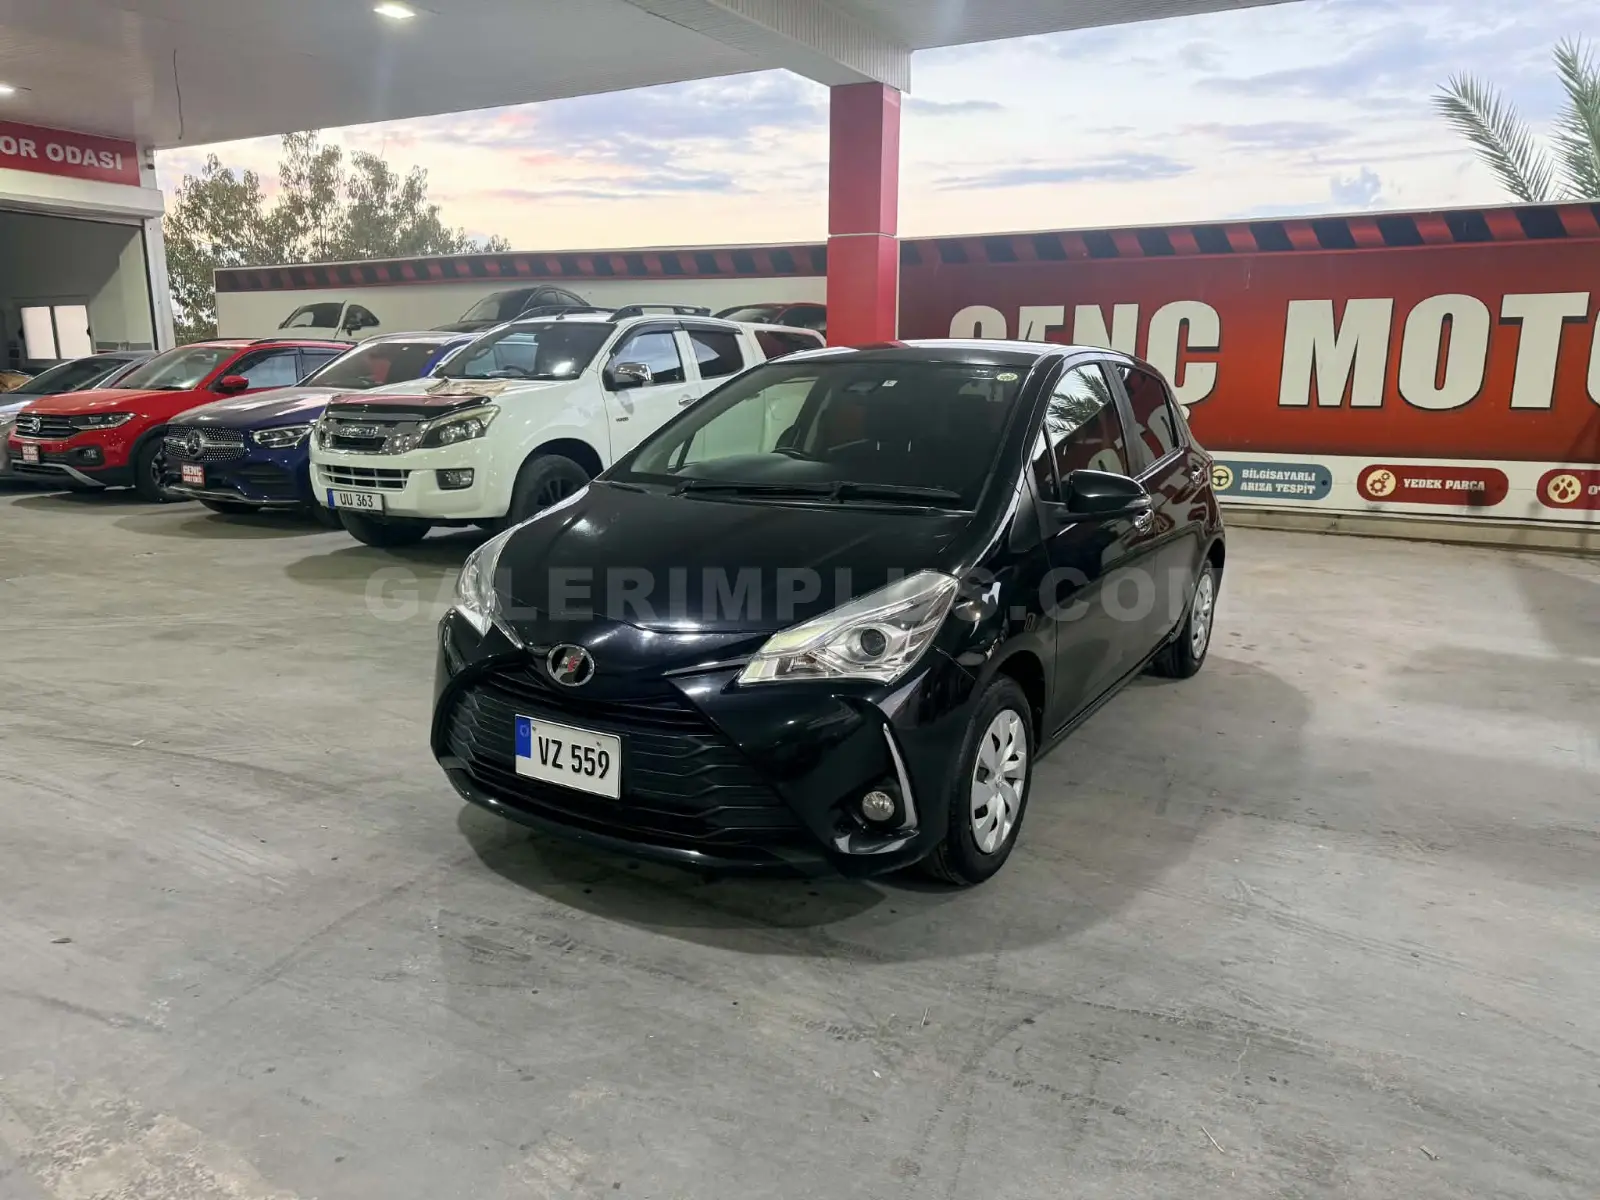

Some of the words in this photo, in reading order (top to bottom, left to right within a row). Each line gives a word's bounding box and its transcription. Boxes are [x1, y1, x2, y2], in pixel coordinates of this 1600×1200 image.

[0, 136, 38, 158] OR
[46, 144, 122, 170] ODASI
[1278, 291, 1600, 409] MOT
[340, 493, 353, 505] UU
[356, 494, 373, 507] 363
[1404, 479, 1443, 489] YEDEK
[538, 736, 563, 769] VZ
[571, 744, 609, 779] 559
